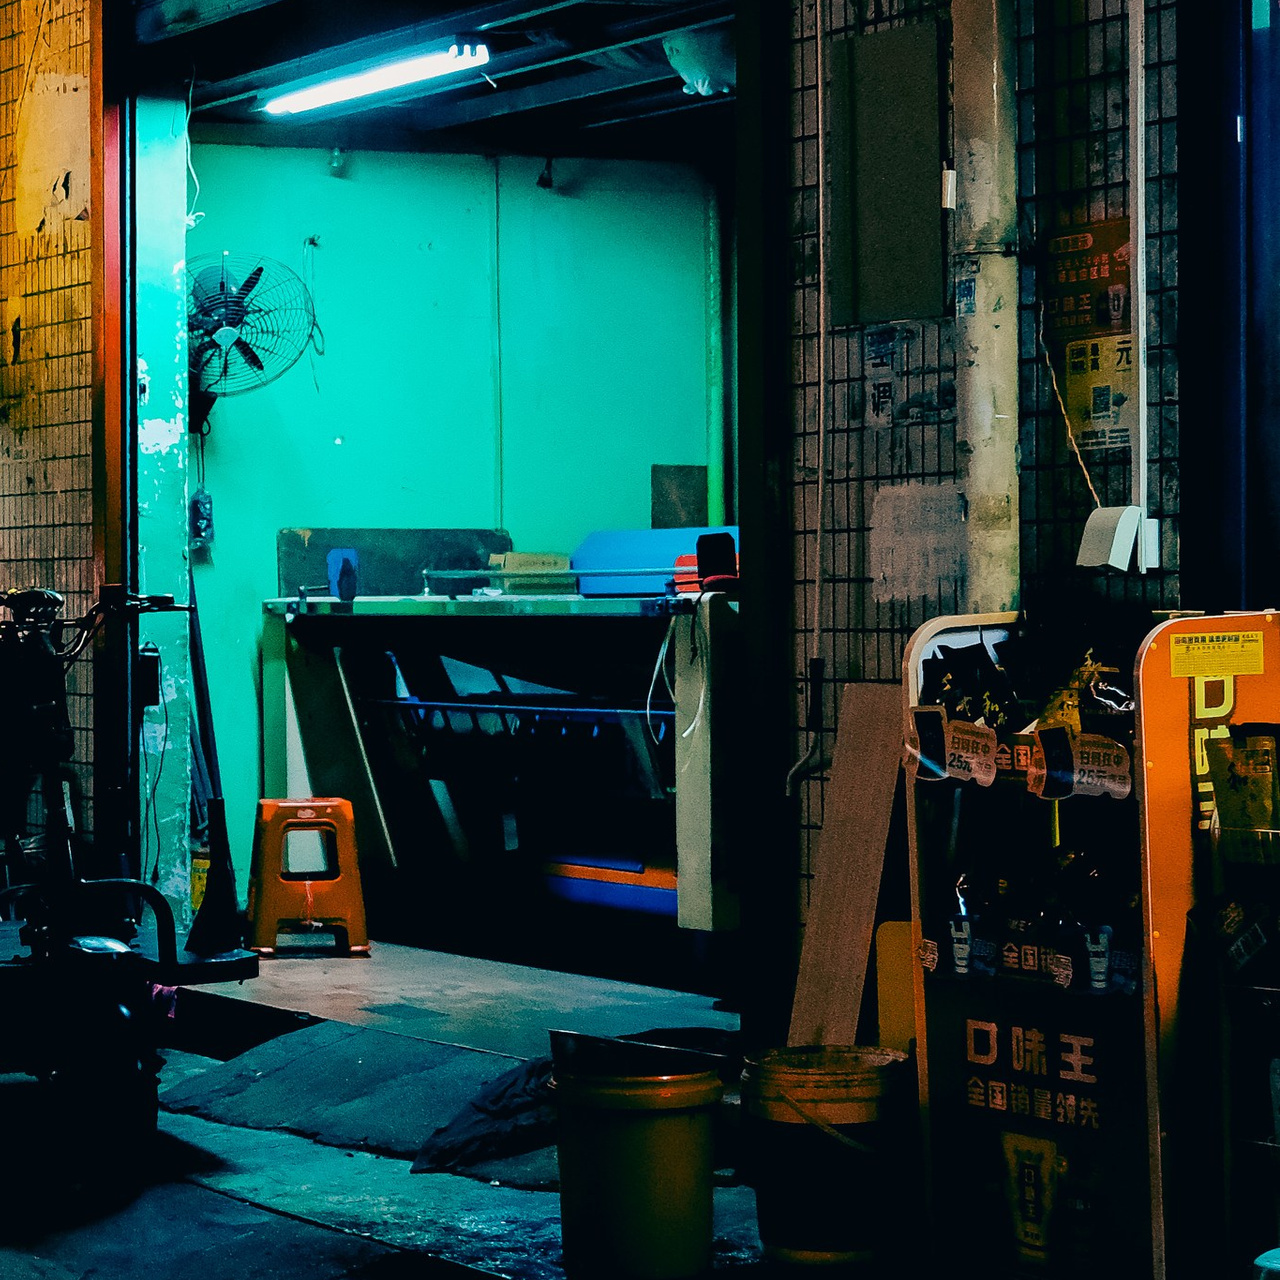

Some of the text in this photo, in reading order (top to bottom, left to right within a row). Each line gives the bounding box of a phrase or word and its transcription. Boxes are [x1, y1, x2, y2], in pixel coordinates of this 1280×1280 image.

[995, 742, 1039, 771] 全国
[966, 1018, 1098, 1084] 口味王
[967, 1075, 1100, 1130] 全国销量领先
